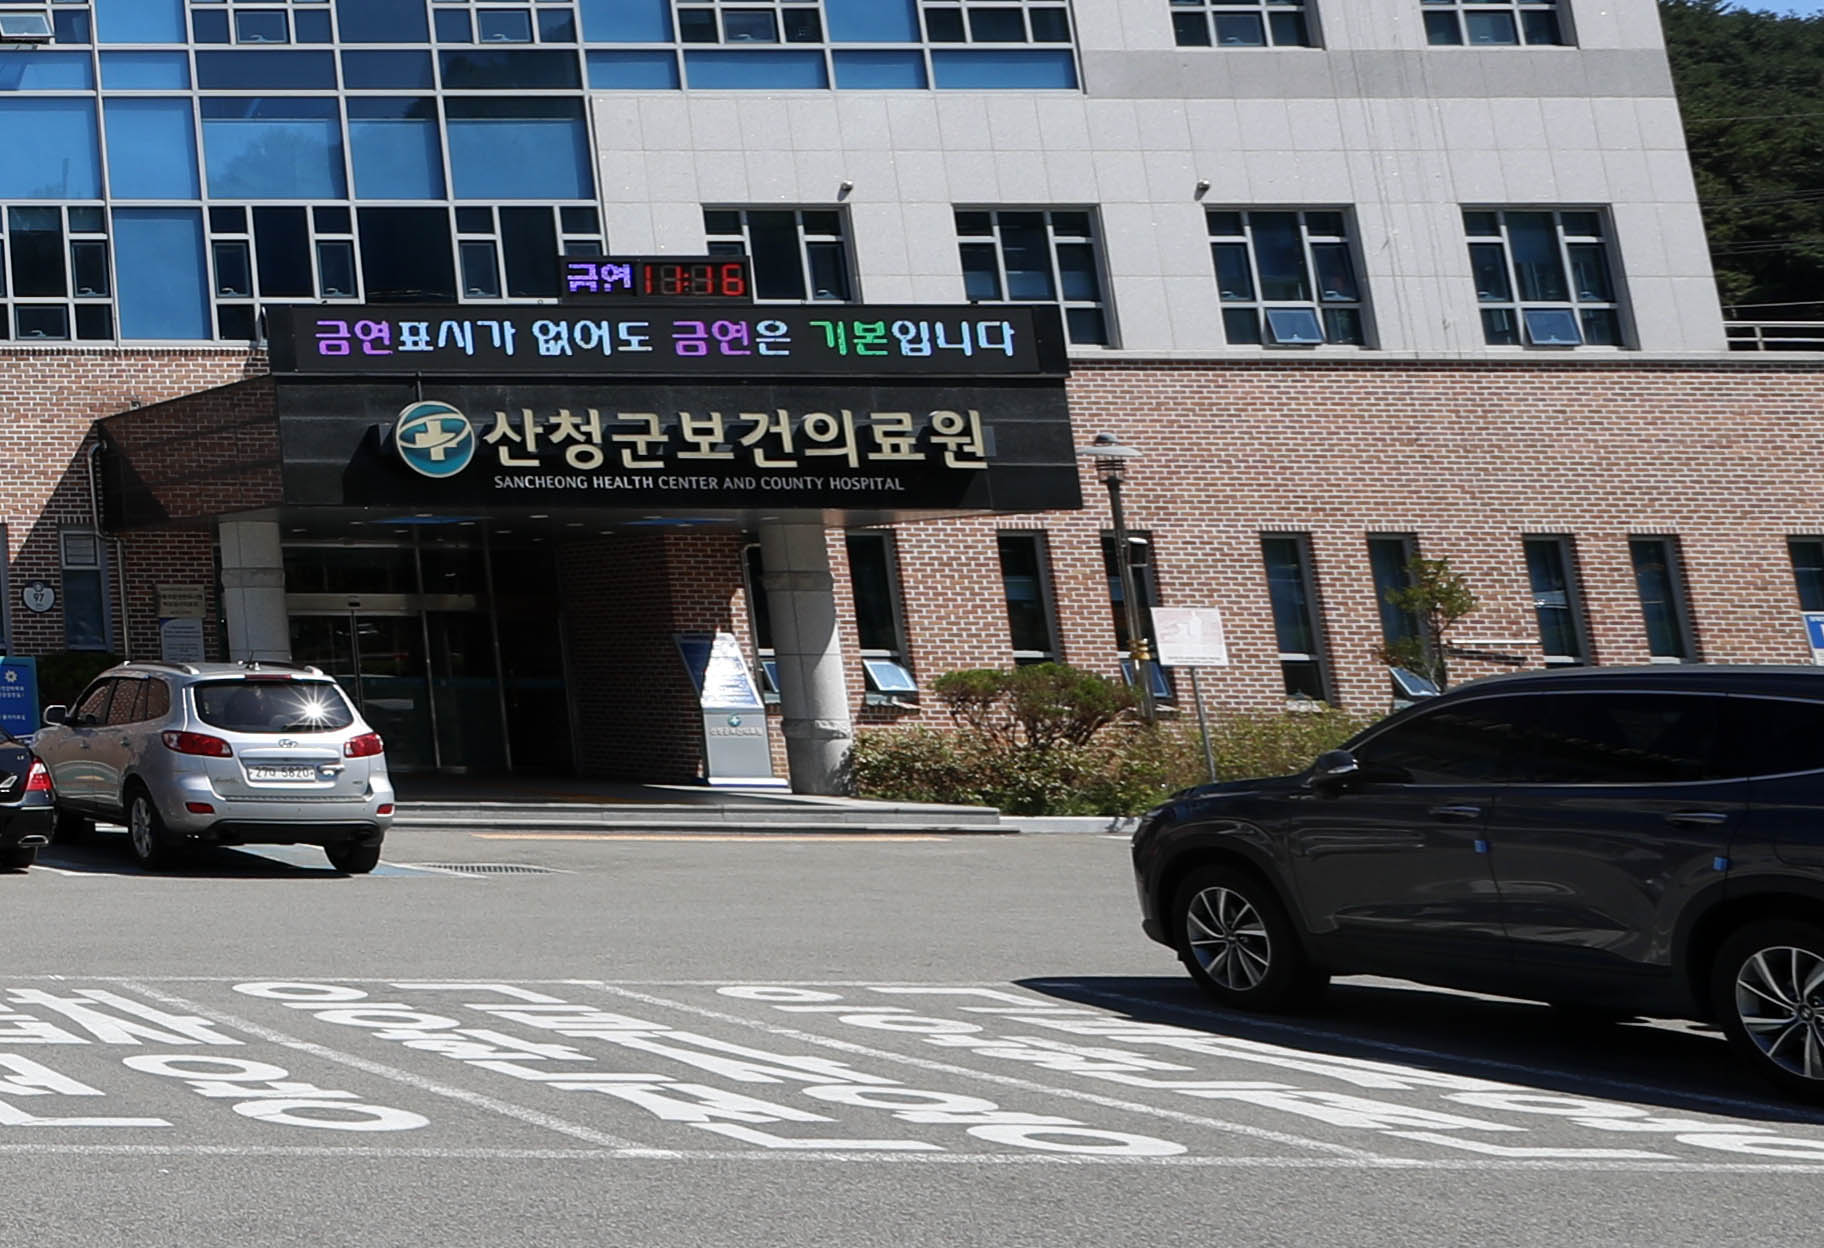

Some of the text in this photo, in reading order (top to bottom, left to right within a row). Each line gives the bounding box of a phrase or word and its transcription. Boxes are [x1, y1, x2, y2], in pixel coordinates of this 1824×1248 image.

[567, 263, 632, 292] 금연
[315, 320, 1015, 356] 금연표시가 없어도 금연은 기본입니다
[484, 408, 989, 470] 산청군보건의료원
[494, 475, 905, 492] SANCHEONG HEALTH CENTER AND COUNTY HOSPITAL
